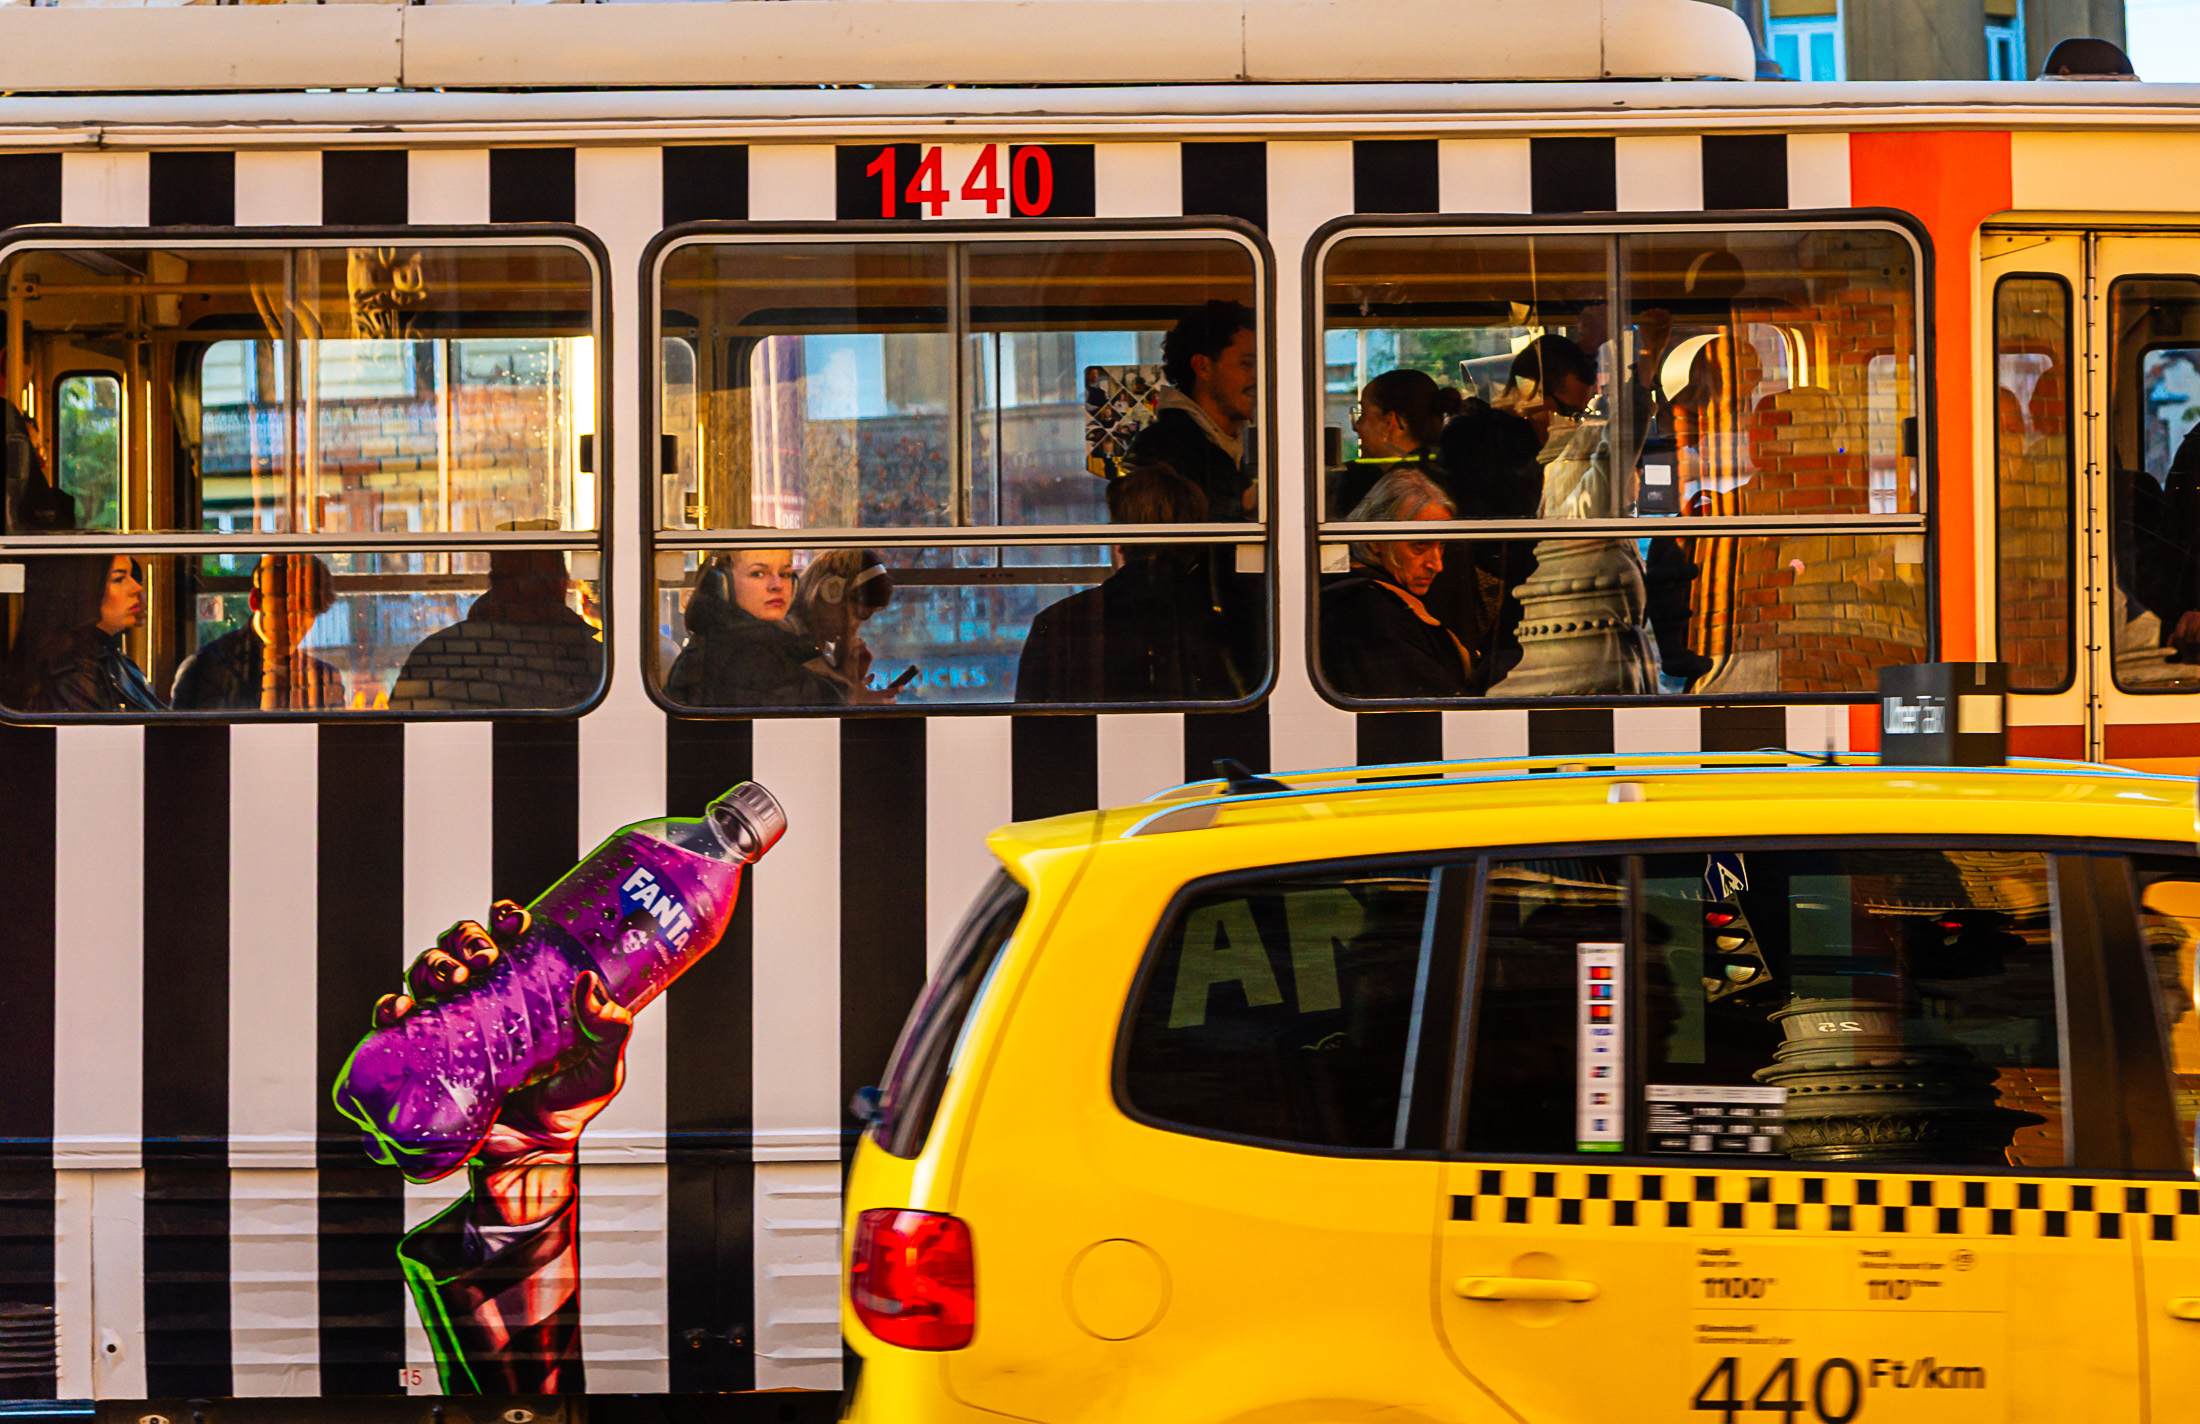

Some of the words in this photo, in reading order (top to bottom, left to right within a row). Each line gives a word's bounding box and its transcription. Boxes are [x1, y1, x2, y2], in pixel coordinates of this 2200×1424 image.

[866, 143, 1053, 218] 1440
[621, 867, 694, 952] FANTA
[401, 1369, 423, 1386] 15
[1690, 1356, 1864, 1424] 440
[1867, 1357, 1986, 1389] Ft/km
